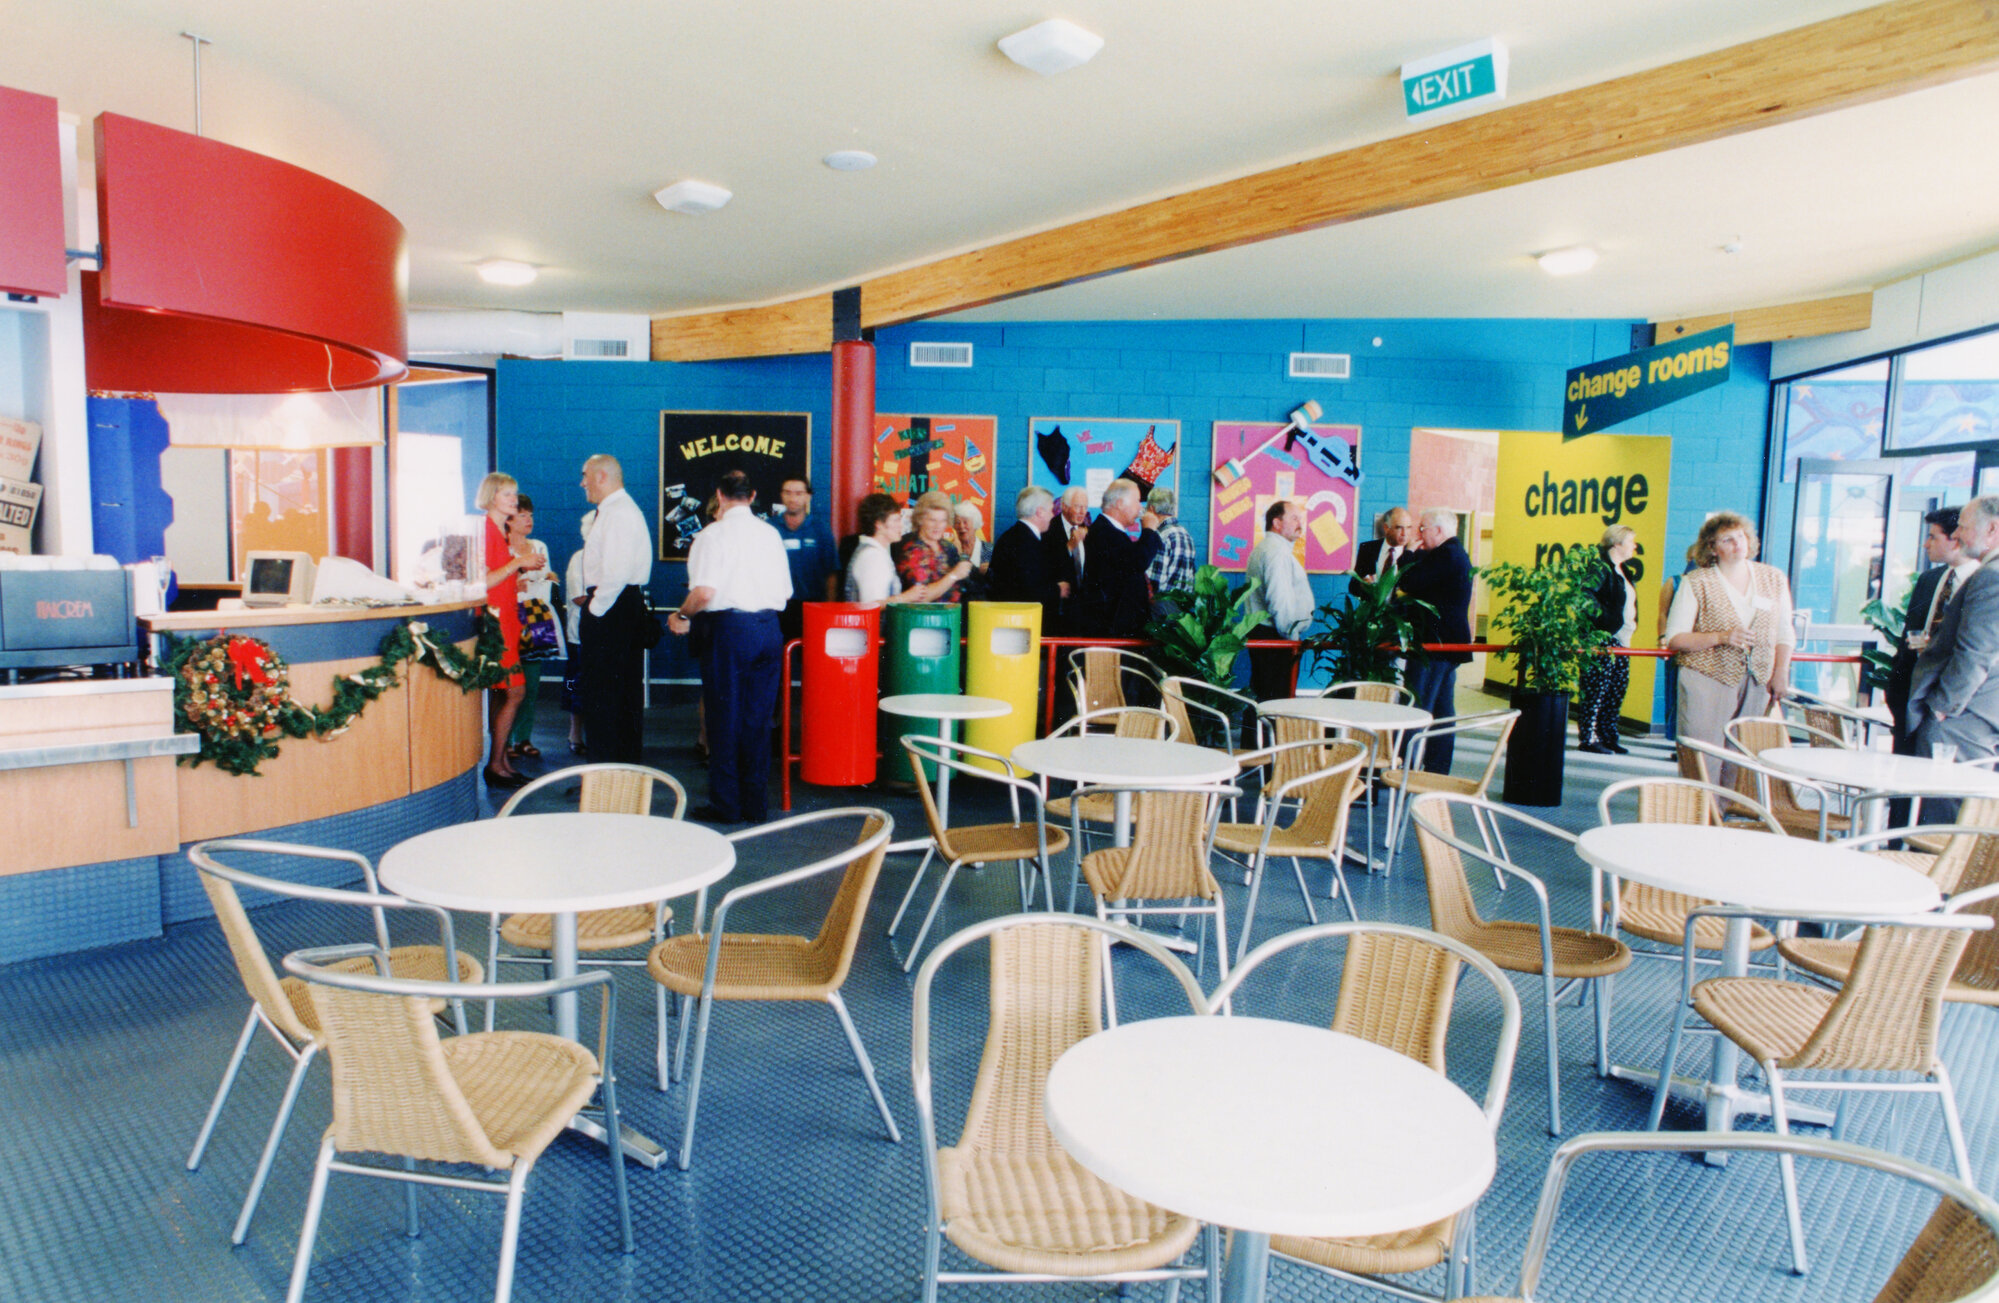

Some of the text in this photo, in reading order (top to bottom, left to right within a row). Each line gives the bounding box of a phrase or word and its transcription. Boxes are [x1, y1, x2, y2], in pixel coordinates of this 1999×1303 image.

[1420, 63, 1475, 106] EXIT
[1567, 341, 1730, 402] change rooms
[680, 433, 786, 460] WELCOME
[1525, 470, 1649, 527] change
